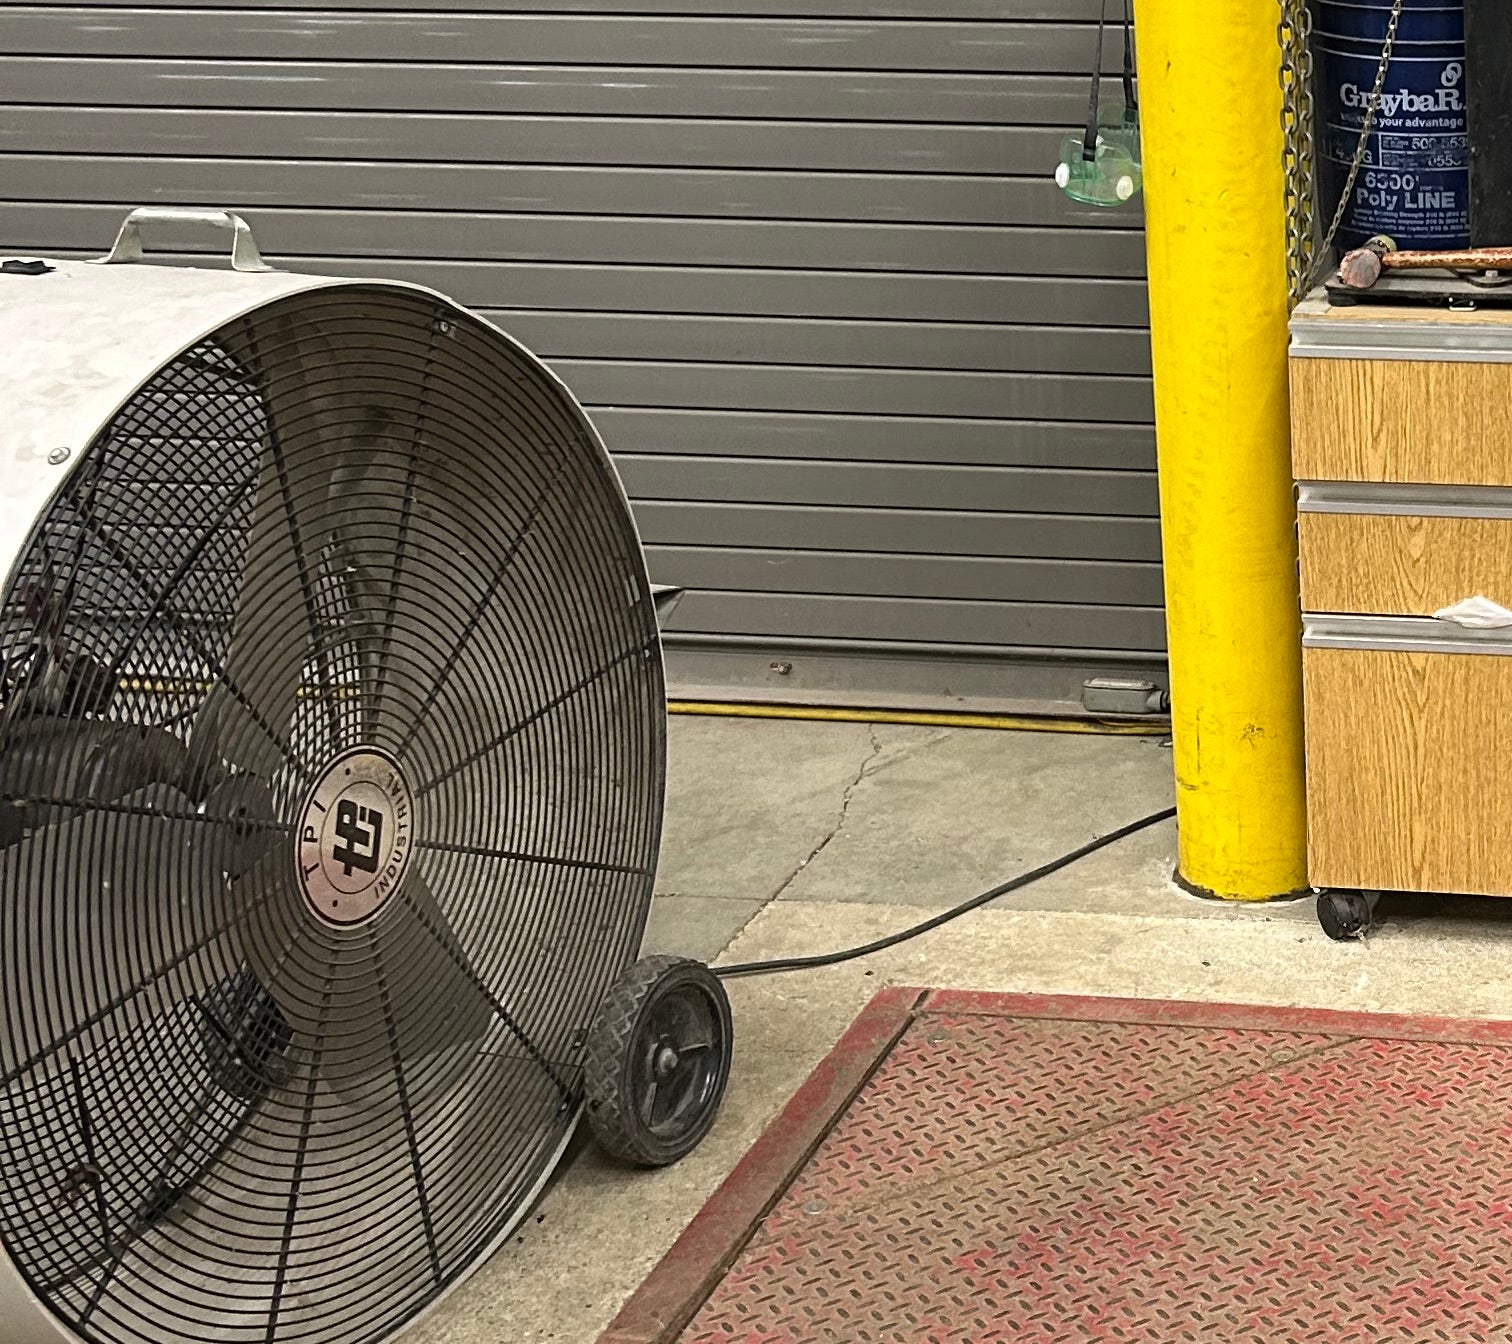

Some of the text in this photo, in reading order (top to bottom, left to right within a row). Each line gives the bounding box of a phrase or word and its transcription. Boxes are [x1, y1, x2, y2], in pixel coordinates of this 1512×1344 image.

[1379, 118, 1403, 128] your
[1405, 116, 1464, 129] advantage
[1357, 187, 1456, 211] Poly LINE
[303, 799, 327, 882] TPI
[374, 772, 409, 900] INDUSTRIAL
